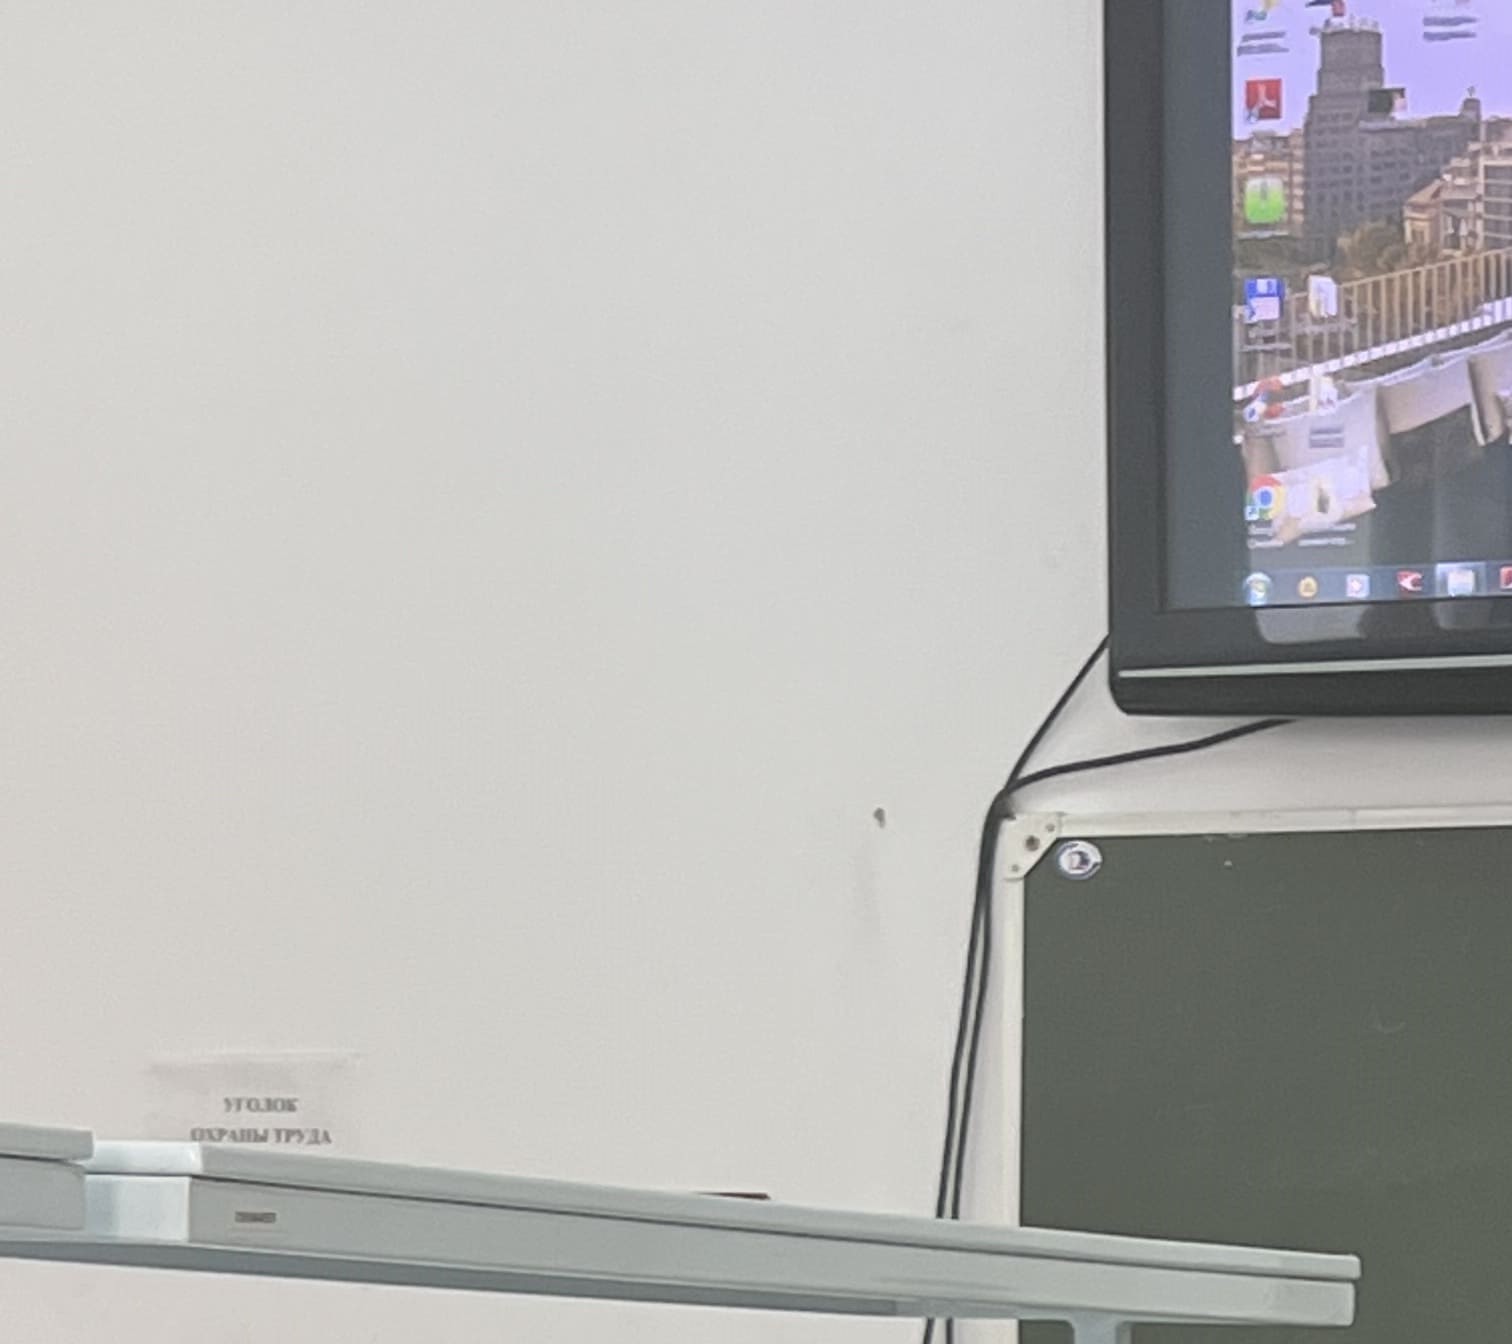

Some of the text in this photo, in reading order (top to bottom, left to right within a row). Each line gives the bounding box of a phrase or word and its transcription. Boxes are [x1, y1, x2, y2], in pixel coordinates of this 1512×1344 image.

[224, 1097, 299, 1113] УГОЛОК
[190, 1127, 332, 1145] ОХРАНЫ ТРУДА
